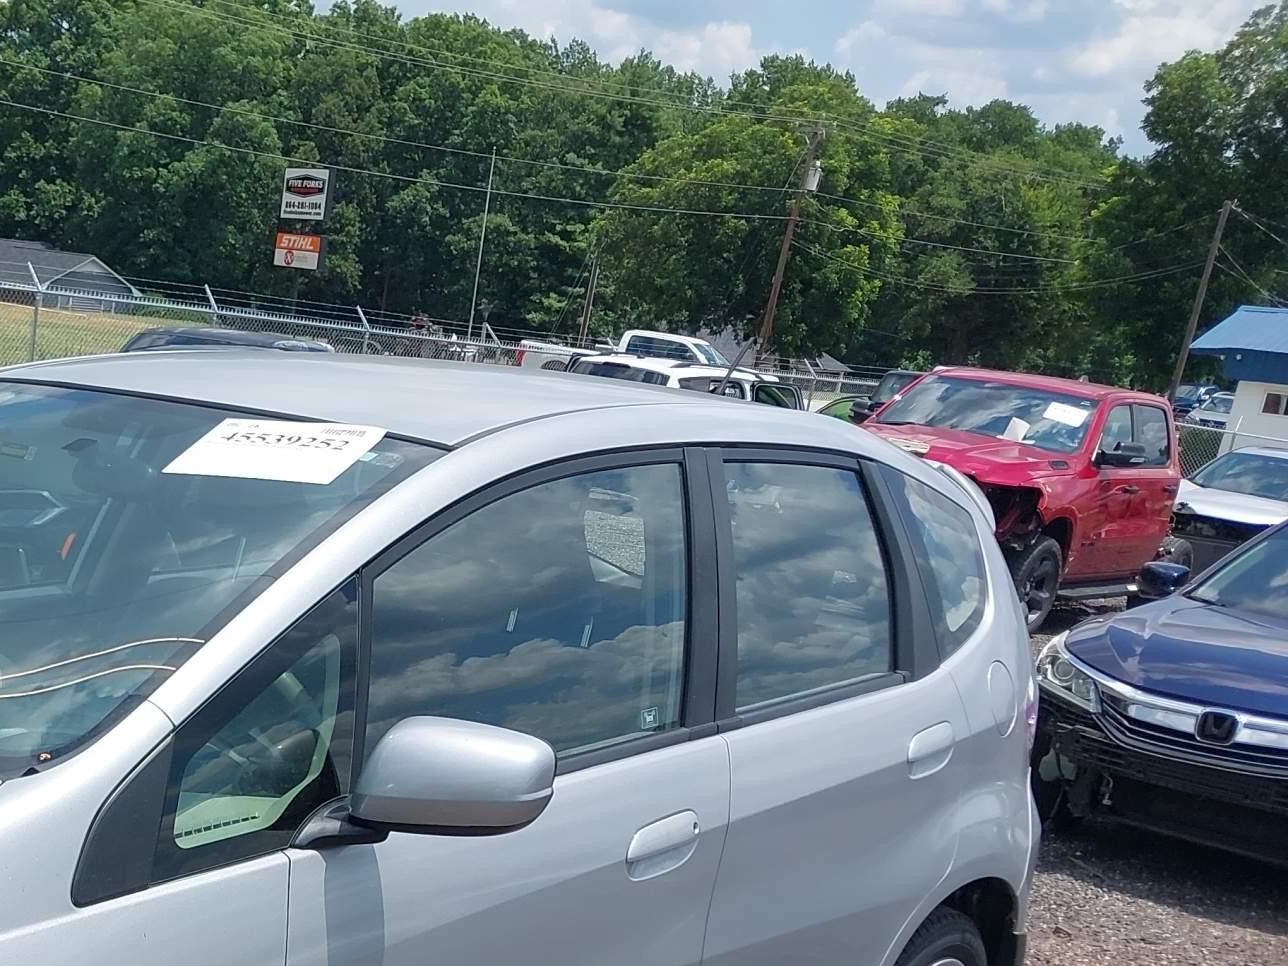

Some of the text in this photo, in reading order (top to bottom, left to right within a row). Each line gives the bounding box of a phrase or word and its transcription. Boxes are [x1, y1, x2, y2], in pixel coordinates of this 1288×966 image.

[288, 180, 324, 189] FIVE FORKS
[280, 235, 314, 249] STIHL
[220, 431, 350, 450] 45539252
